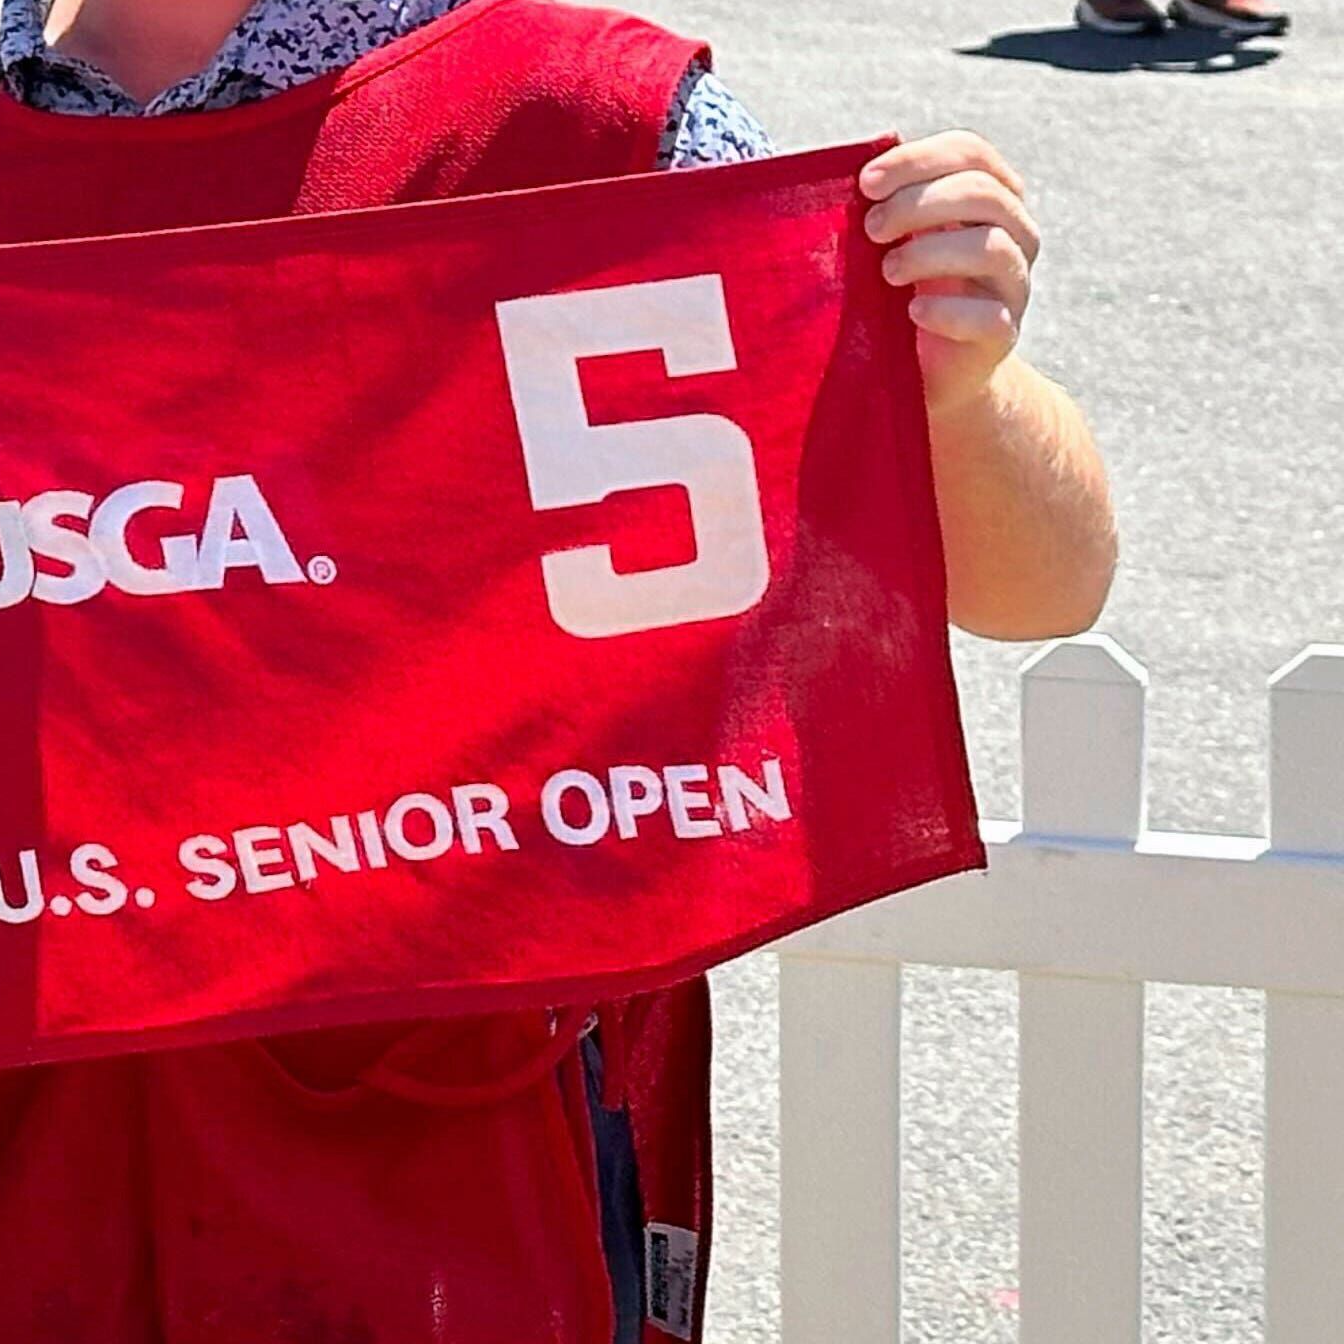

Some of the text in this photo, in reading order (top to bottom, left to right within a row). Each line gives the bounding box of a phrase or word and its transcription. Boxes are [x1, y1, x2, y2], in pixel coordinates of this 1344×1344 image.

[496, 274, 771, 639] 5
[178, 784, 520, 900] SENIOR
[540, 758, 793, 846] OPEN
